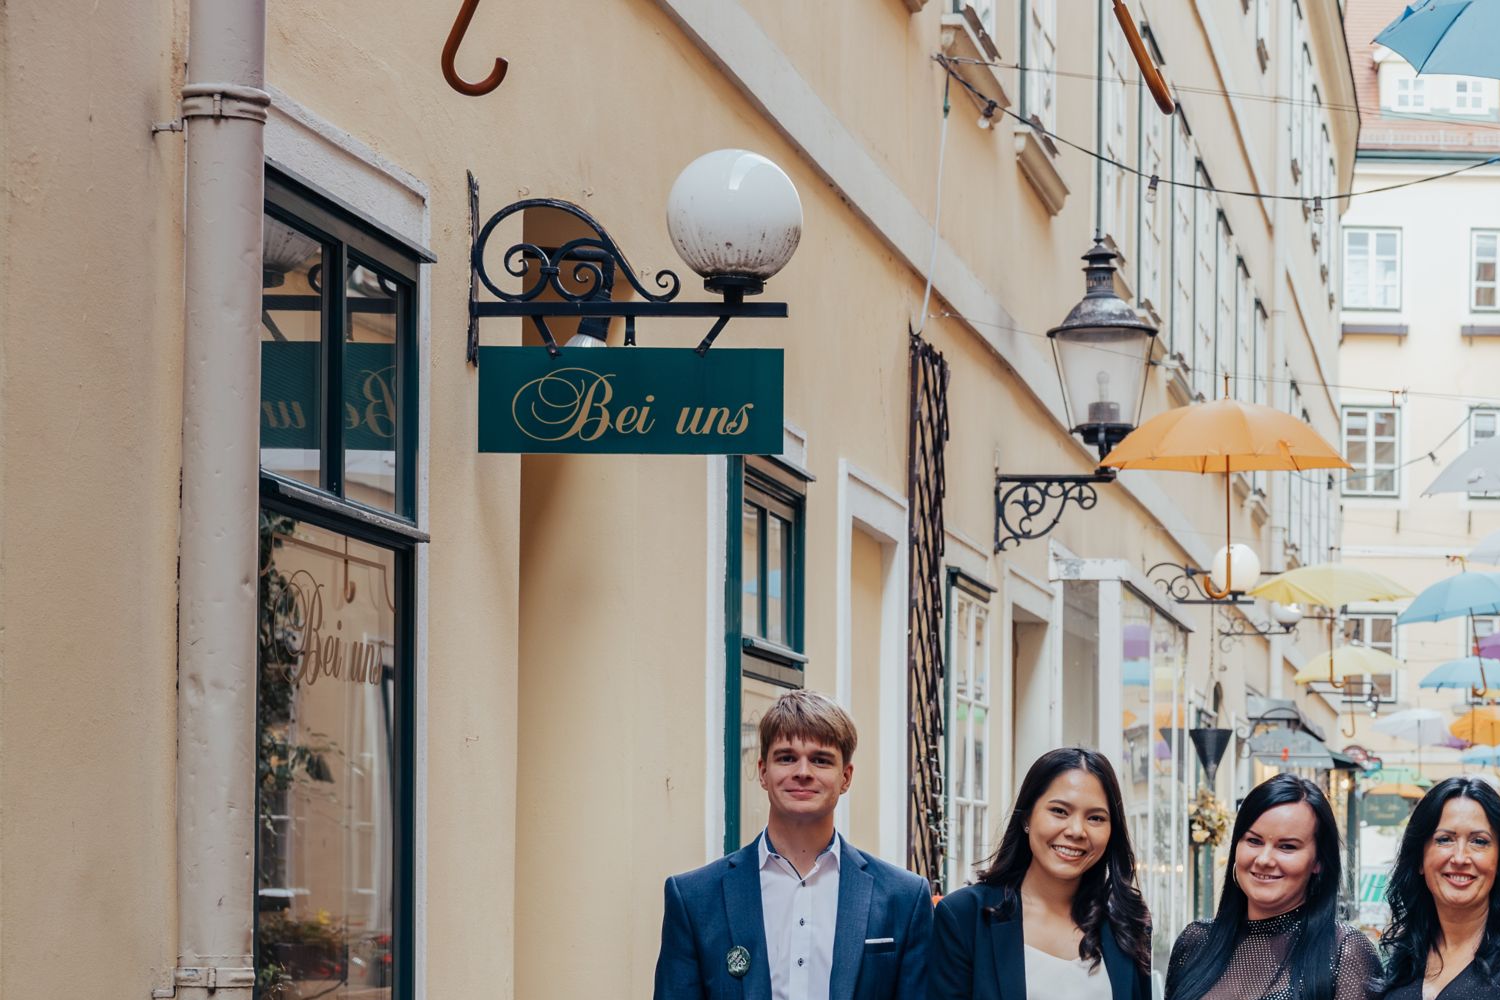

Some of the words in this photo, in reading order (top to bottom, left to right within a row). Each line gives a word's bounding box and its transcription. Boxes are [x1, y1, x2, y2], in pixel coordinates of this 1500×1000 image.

[511, 367, 655, 441] Bei
[675, 403, 754, 435] uns
[274, 570, 343, 686] Bei
[351, 640, 384, 686] uns
